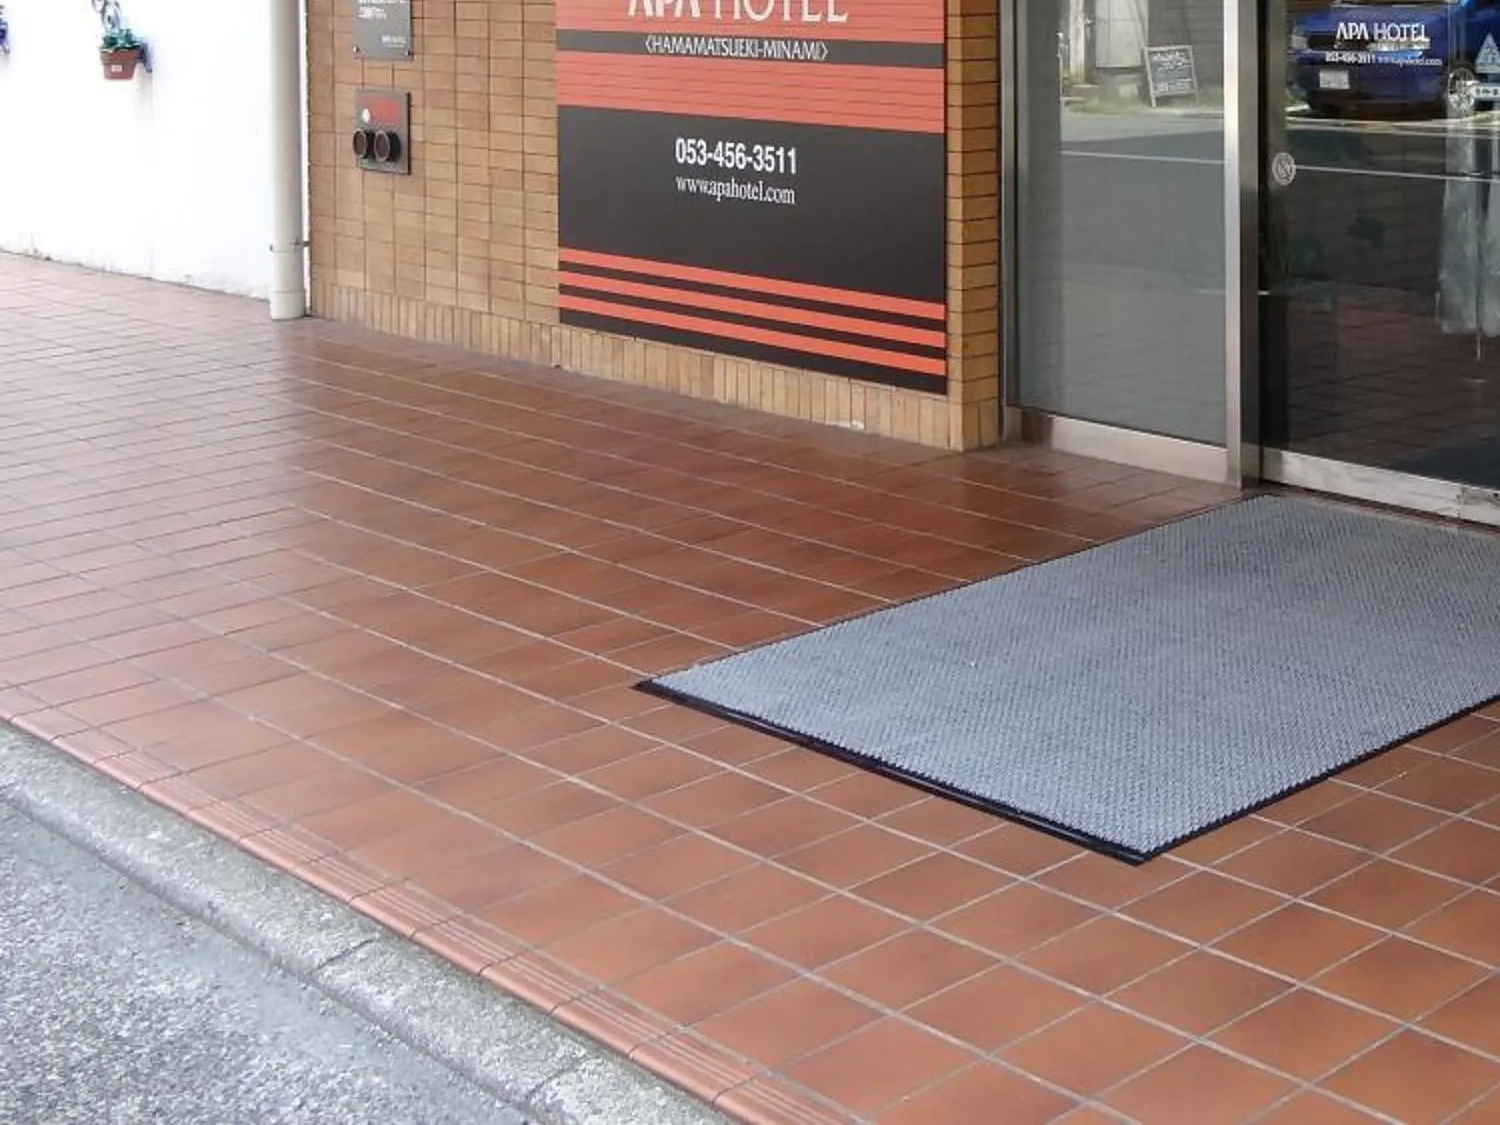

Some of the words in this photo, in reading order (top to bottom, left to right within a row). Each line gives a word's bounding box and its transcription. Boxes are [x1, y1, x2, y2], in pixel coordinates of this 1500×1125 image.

[1336, 21, 1369, 41] APA
[1373, 22, 1431, 42] HOTEL
[675, 136, 797, 175] 053-456-3511
[675, 176, 796, 204] www.apahotel.com
